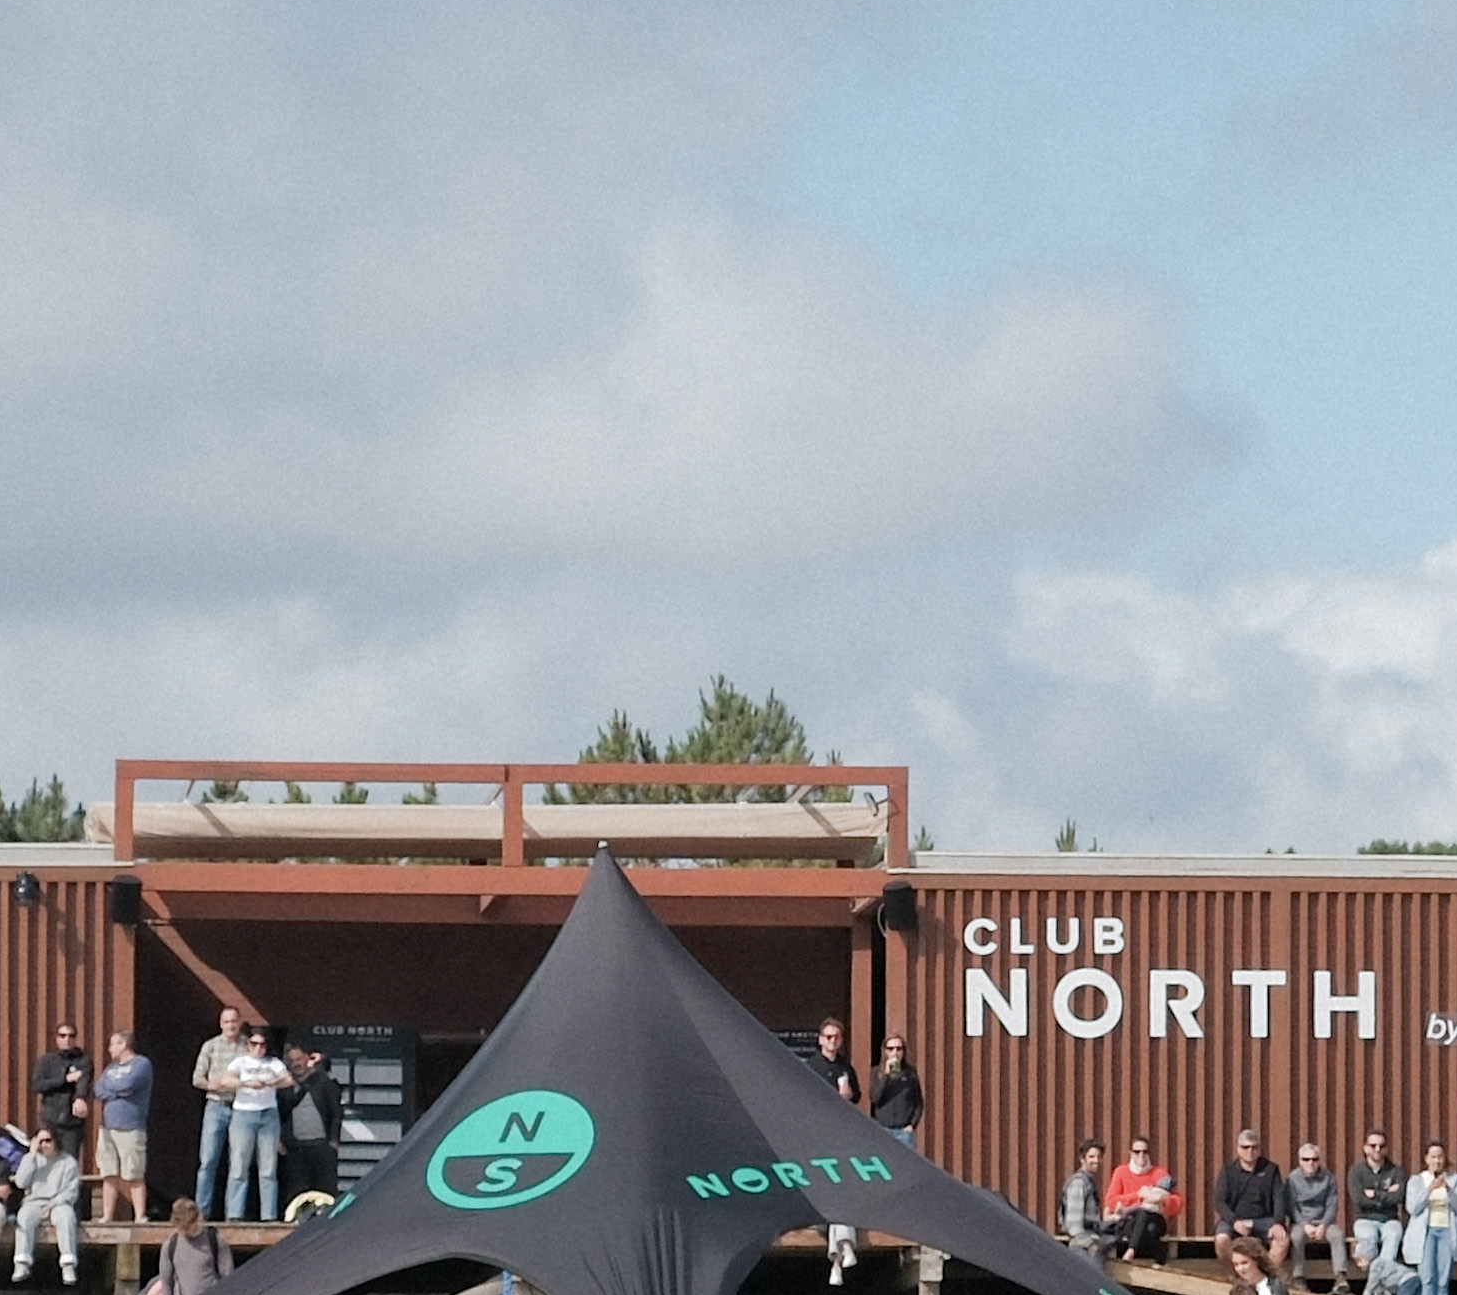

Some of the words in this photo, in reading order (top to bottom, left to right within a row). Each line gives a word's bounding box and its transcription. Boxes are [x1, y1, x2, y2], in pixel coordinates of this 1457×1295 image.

[963, 917, 1125, 955] CLUB
[965, 967, 1376, 1040] NORTH
[312, 1025, 344, 1036] CLUB
[347, 1025, 394, 1037] NORTH
[499, 1111, 546, 1143] N
[476, 1157, 523, 1193] S
[686, 1154, 893, 1199] NORTH
